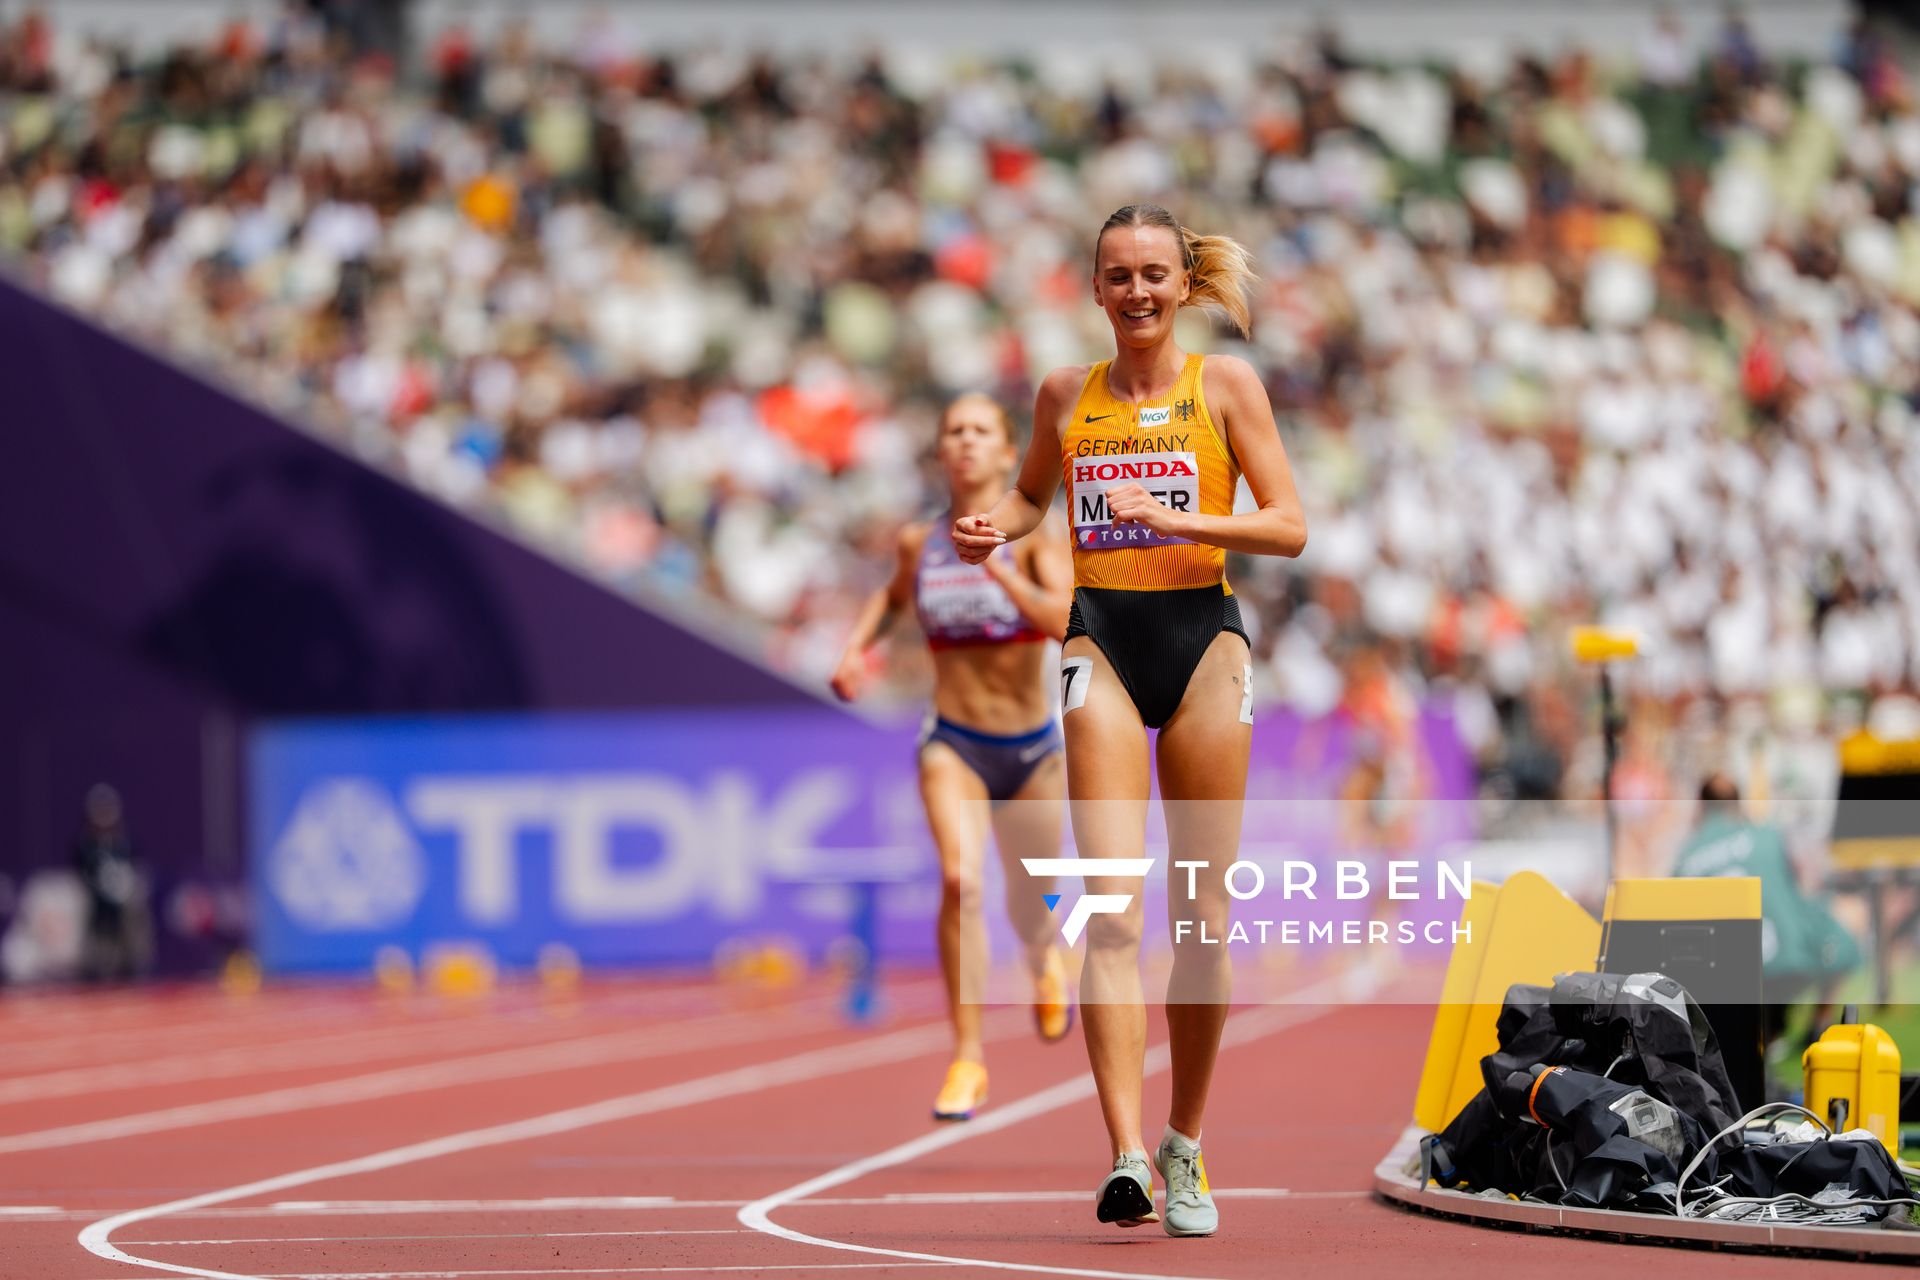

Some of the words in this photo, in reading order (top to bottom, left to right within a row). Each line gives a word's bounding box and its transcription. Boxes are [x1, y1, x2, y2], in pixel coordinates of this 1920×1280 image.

[1140, 411, 1169, 422] WGV
[1077, 434, 1189, 457] GERMANY
[1075, 460, 1196, 483] HONDA
[1101, 529, 1167, 541] TOKY
[1062, 665, 1080, 707] 7
[411, 774, 856, 922] TDK
